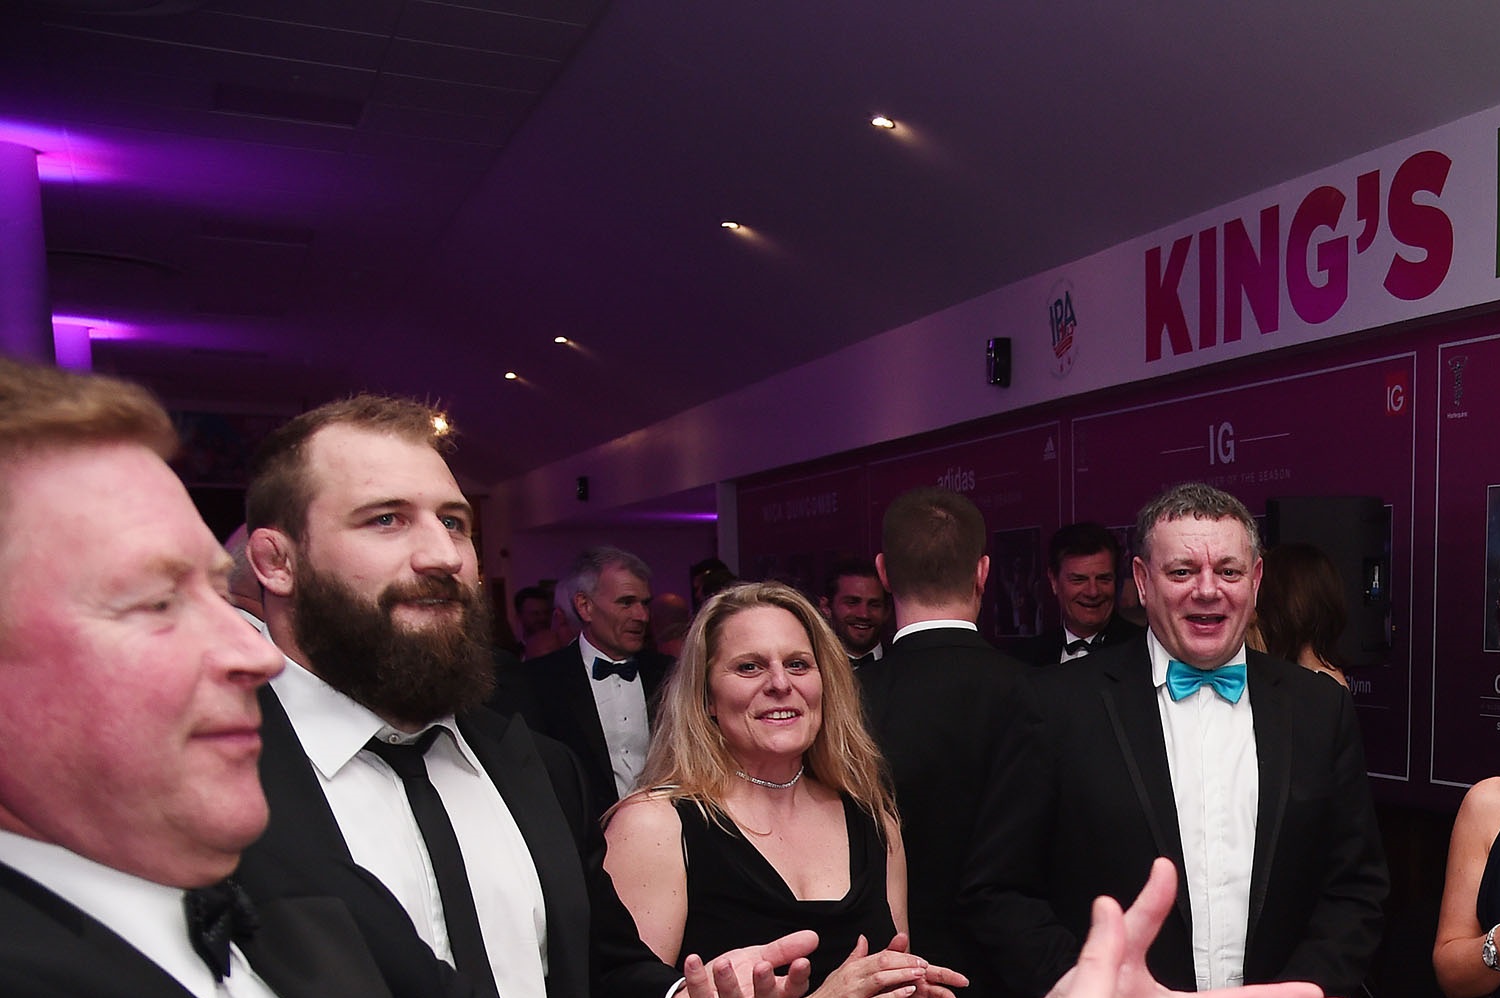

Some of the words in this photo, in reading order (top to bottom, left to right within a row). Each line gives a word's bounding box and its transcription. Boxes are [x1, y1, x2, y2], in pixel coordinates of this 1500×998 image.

[1144, 150, 1454, 363] KING'S
[1049, 291, 1077, 346] IPA
[1386, 384, 1404, 413] IG
[1209, 421, 1236, 465] IG
